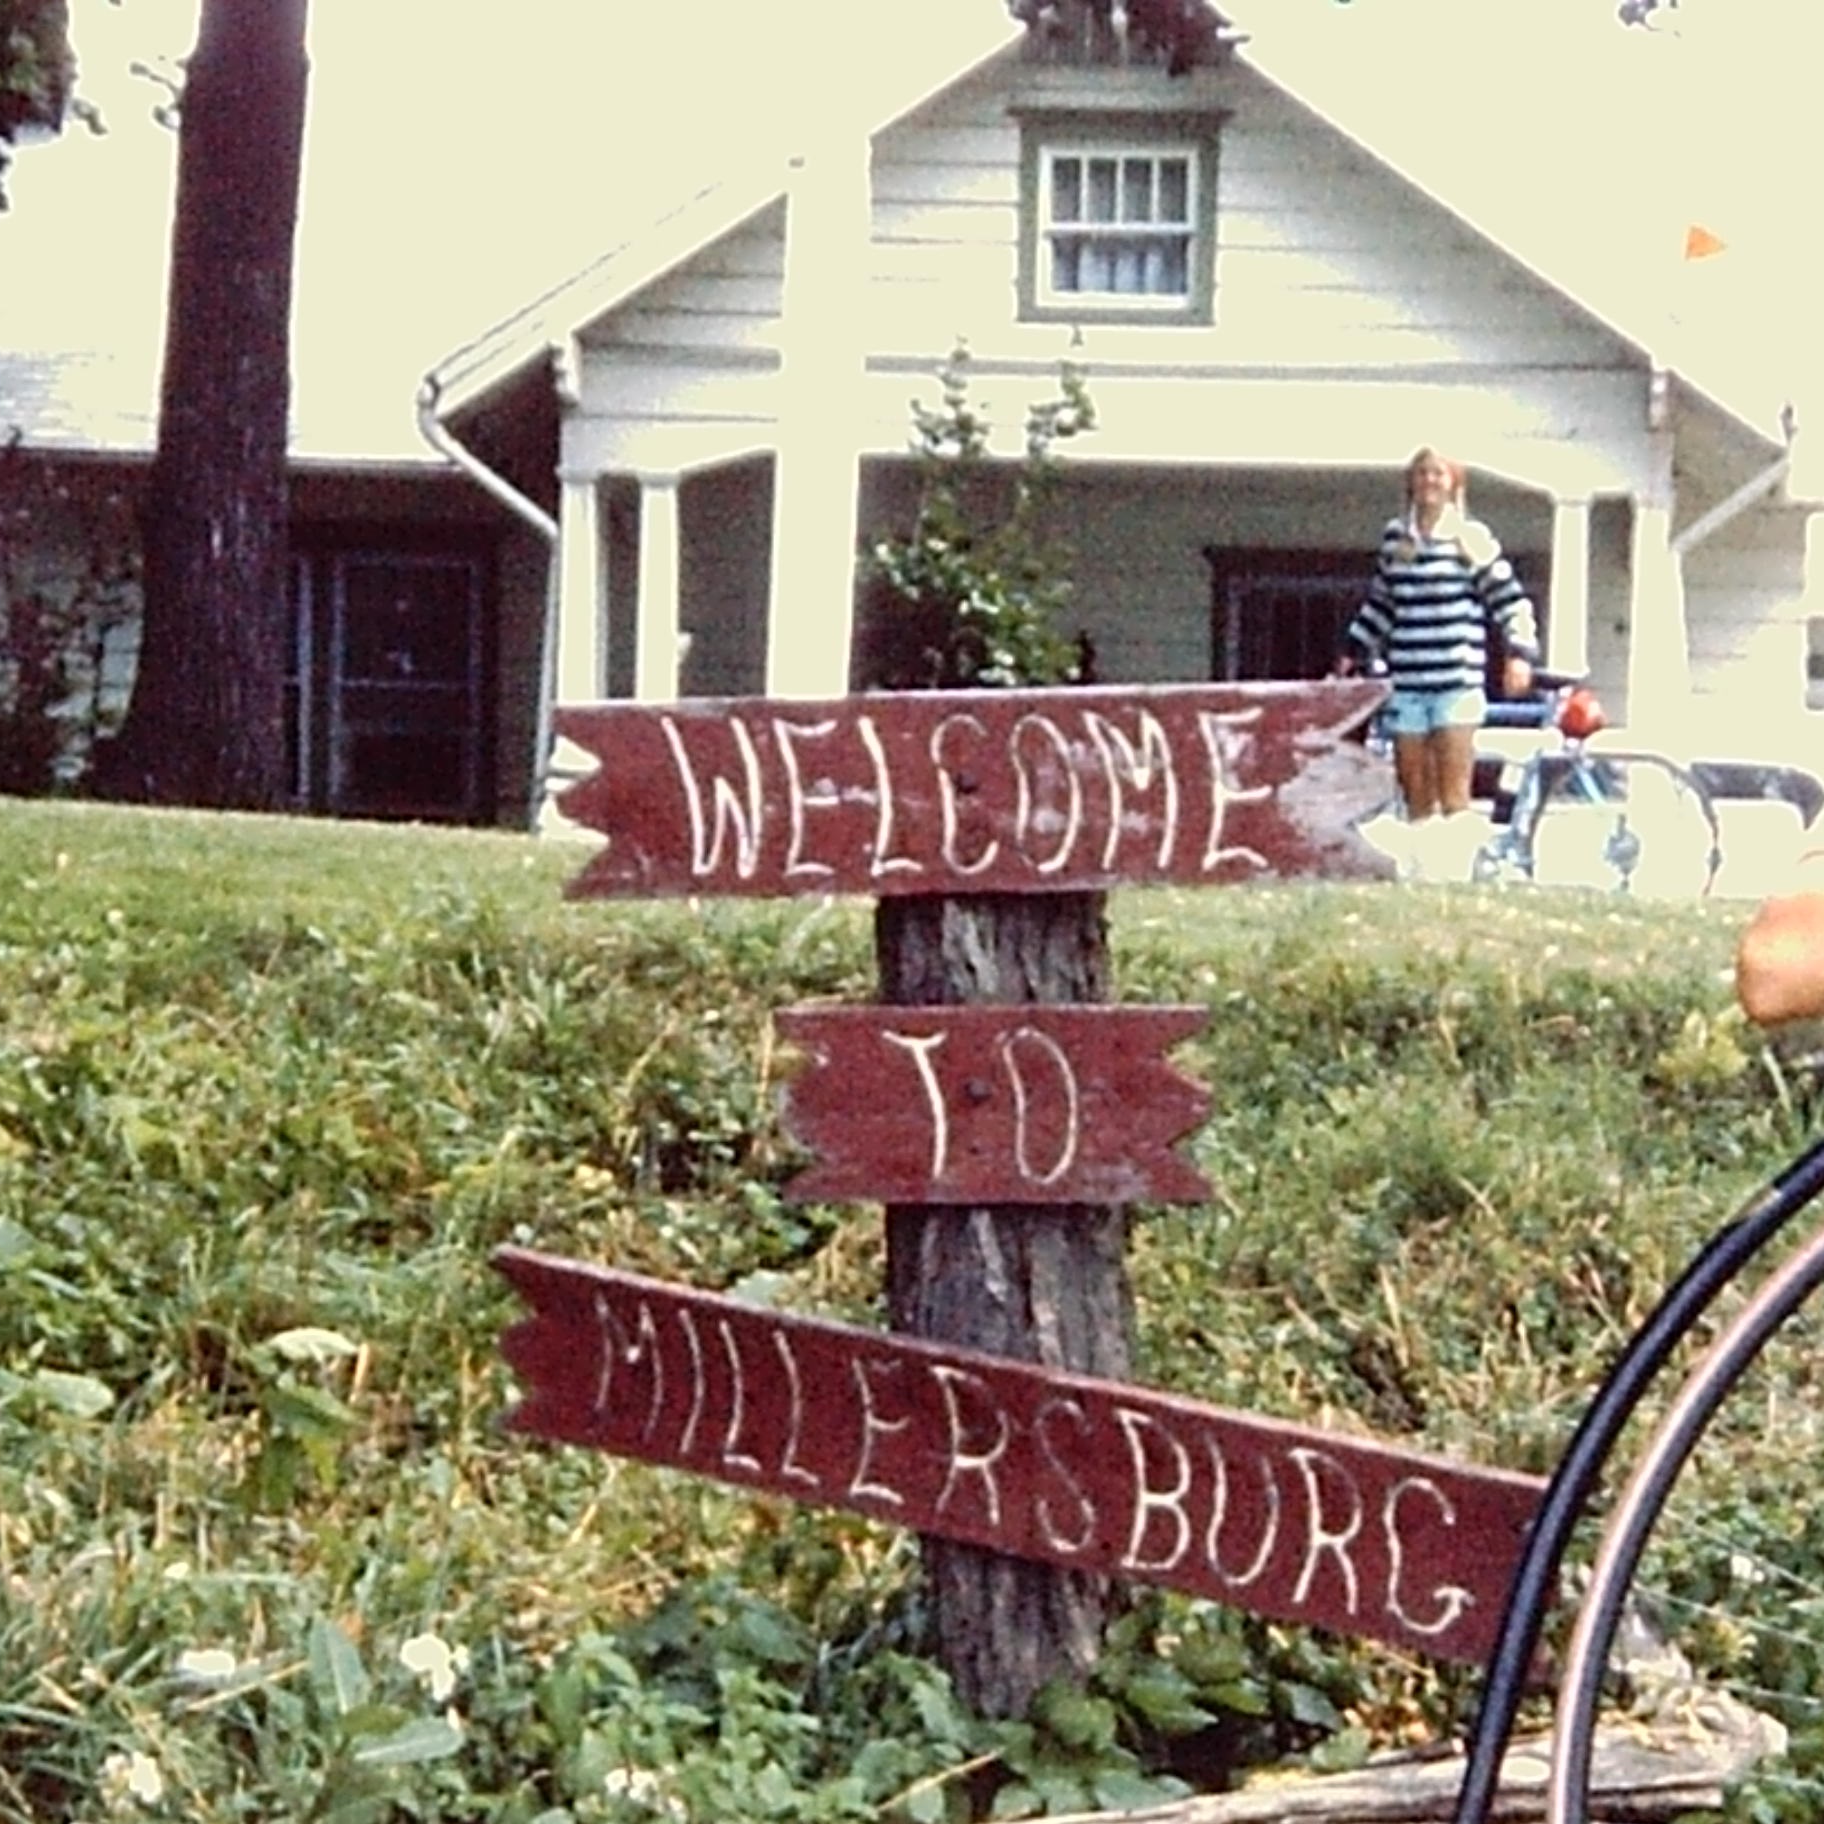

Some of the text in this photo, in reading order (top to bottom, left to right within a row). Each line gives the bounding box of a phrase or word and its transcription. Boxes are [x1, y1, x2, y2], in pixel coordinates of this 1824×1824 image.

[661, 706, 1273, 880] WELCOME
[881, 1025, 1078, 1185] TO
[593, 1290, 1476, 1635] MILLERSBURG
